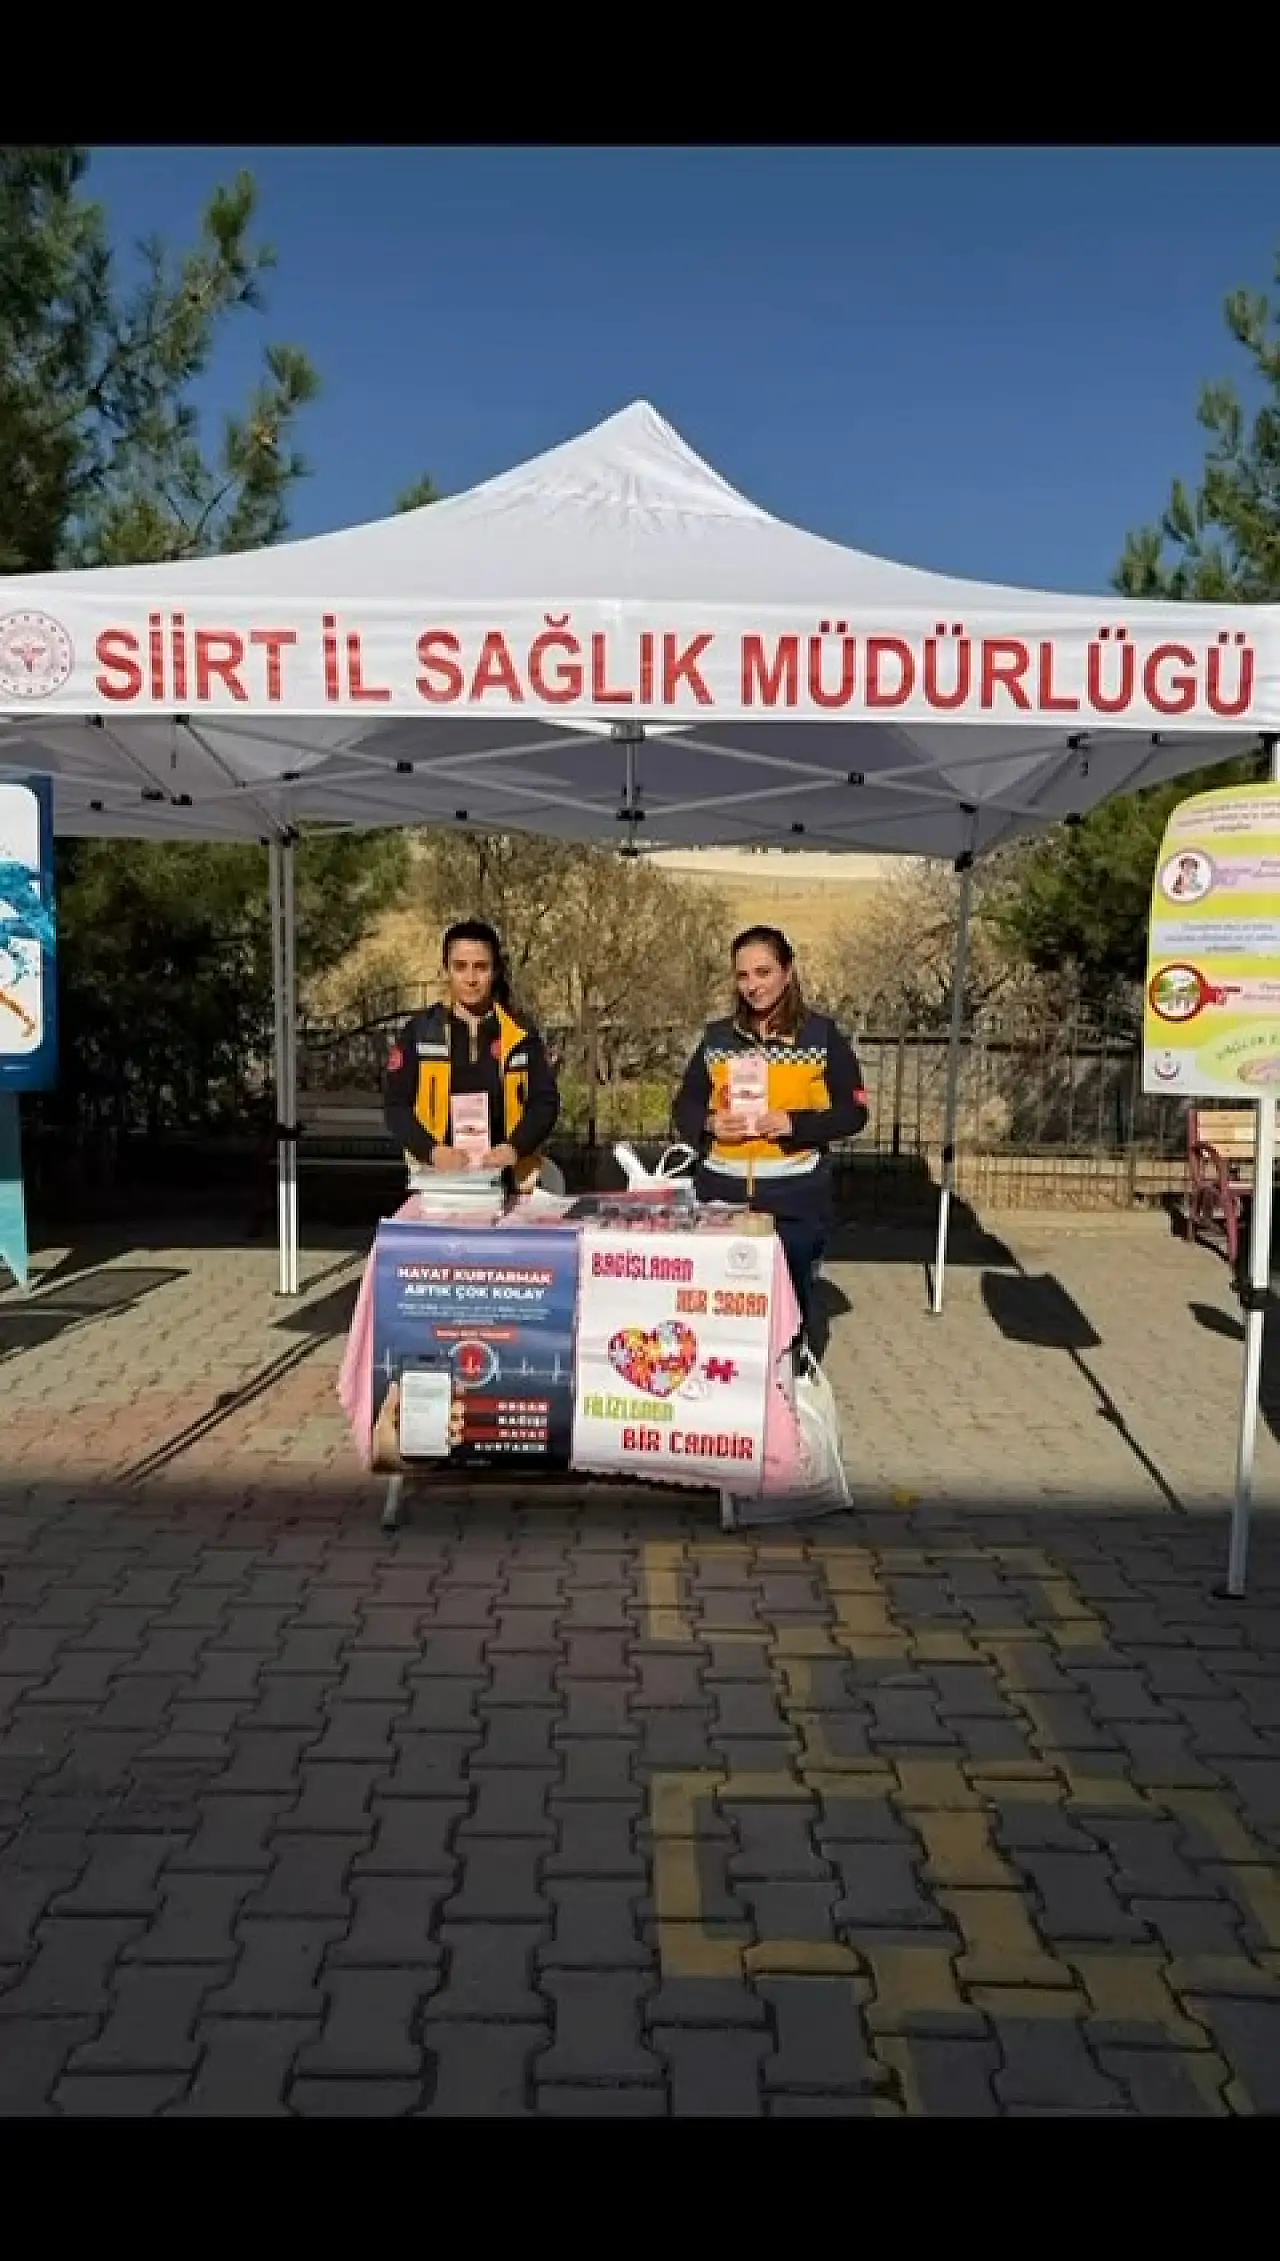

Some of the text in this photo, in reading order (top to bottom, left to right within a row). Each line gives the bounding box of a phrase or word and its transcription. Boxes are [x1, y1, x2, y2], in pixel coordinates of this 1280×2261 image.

[95, 612, 297, 702] SİİRT
[322, 613, 391, 702] İL
[415, 612, 714, 705] SAĞLIK
[623, 1425, 661, 1451] BİR
